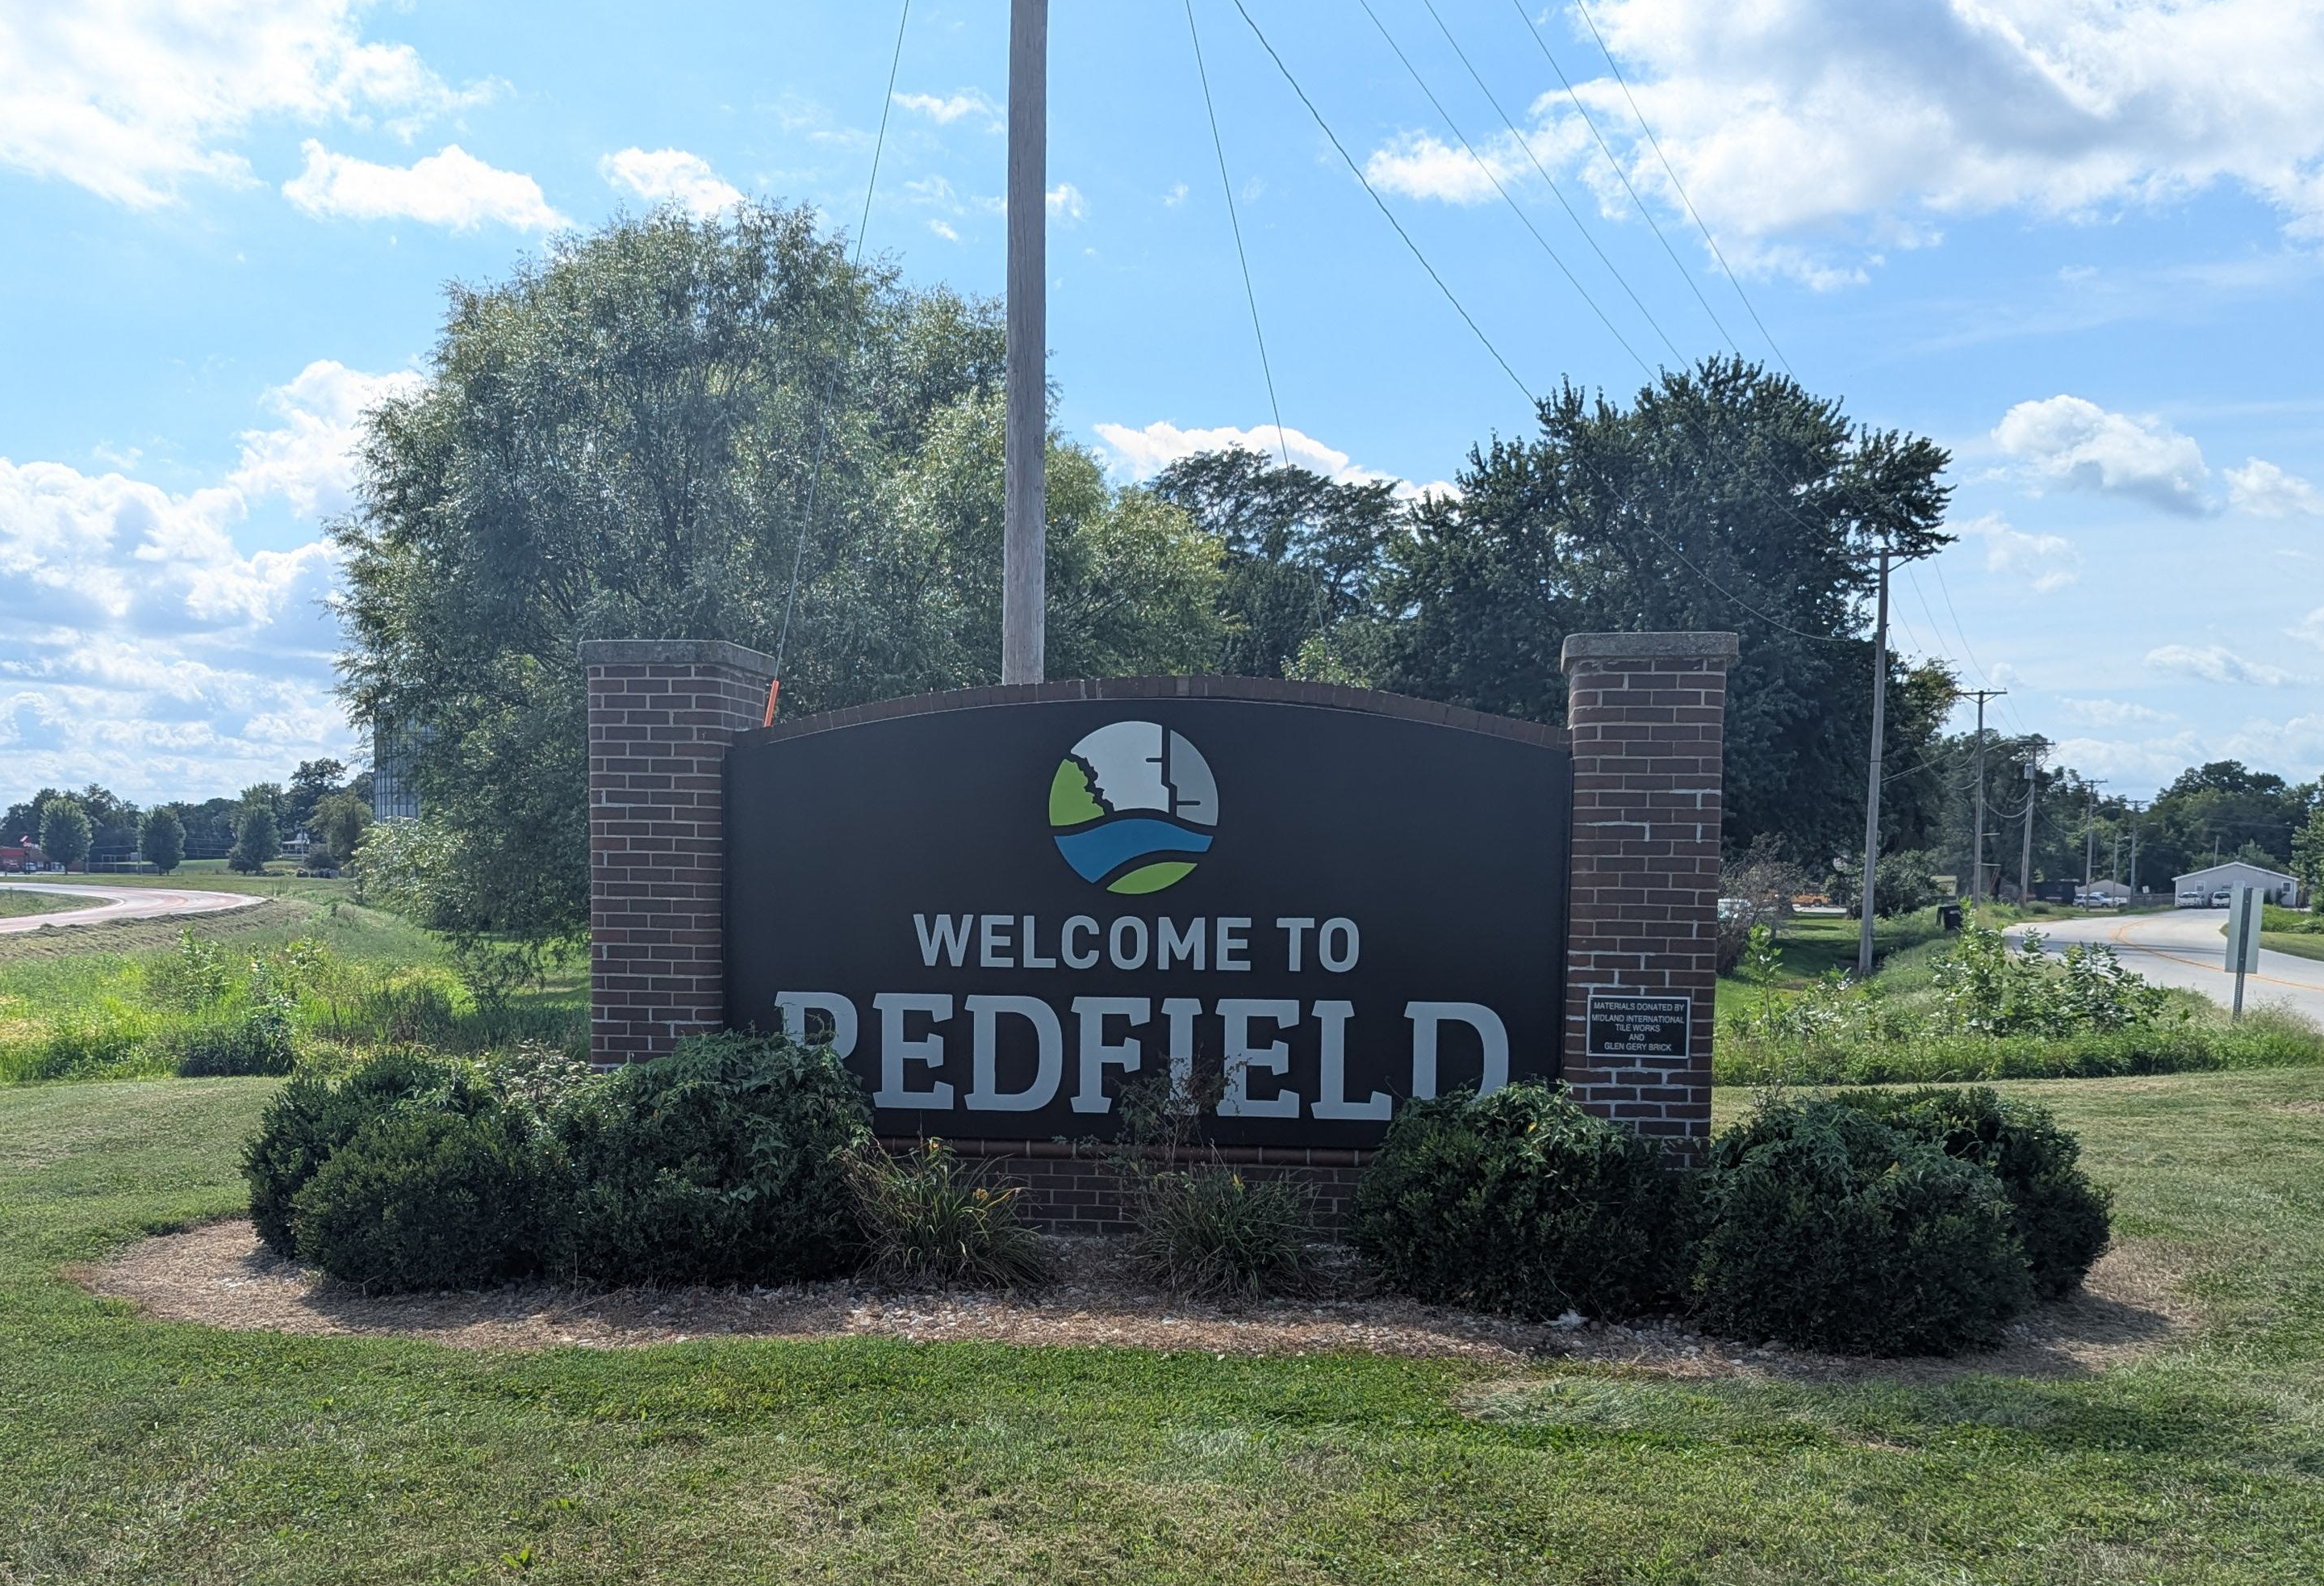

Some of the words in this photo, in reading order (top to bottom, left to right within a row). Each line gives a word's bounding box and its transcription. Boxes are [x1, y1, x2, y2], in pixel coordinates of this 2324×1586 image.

[913, 914, 1252, 972] WELCOME
[1277, 917, 1360, 973] TO
[1593, 1002, 1635, 1011] MATERIALS
[1636, 1002, 1673, 1011] DONATED
[1591, 1014, 1624, 1022] MIDLAND
[1626, 1015, 1685, 1024] INTERNATIONAL
[1615, 1023, 1631, 1032] TILE
[1632, 1024, 1661, 1032] WORKS
[1604, 1042, 1624, 1050] GLEN
[1625, 1043, 1647, 1051] GERY
[1649, 1044, 1671, 1052] BRICK
